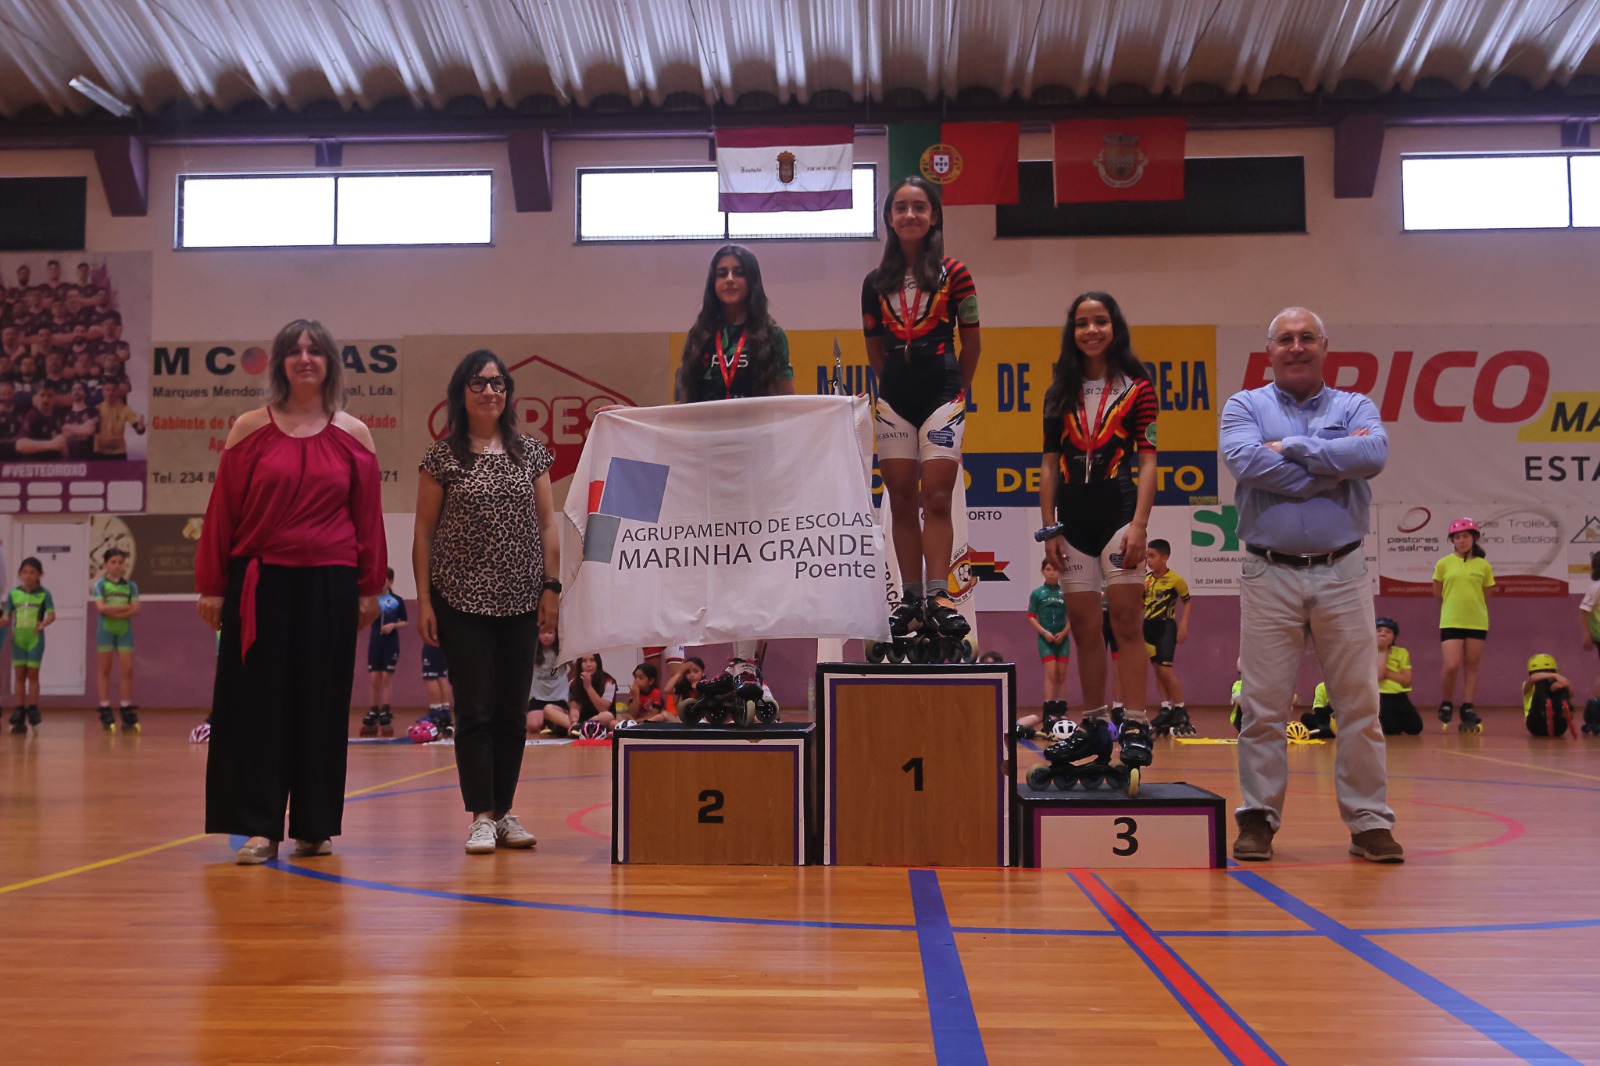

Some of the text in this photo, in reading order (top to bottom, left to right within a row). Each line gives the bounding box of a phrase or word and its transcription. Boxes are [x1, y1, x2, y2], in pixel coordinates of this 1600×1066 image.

[153, 347, 190, 376] M
[152, 387, 208, 398] Marques
[213, 386, 266, 398] Mendon
[369, 385, 397, 396] Lda.
[998, 363, 1031, 412] DE
[152, 416, 205, 430] Gabinete
[209, 416, 224, 429] de
[153, 472, 175, 483] Tel.
[180, 471, 203, 483] 234
[621, 512, 873, 543] AGRUPAMENTO DE ESCOLAS
[618, 534, 875, 571] MARINHA GRANDE
[1398, 544, 1439, 552] salreu
[795, 560, 876, 579] Poente
[902, 758, 924, 791] 1
[698, 790, 724, 824] 2
[1112, 817, 1139, 856] 3
